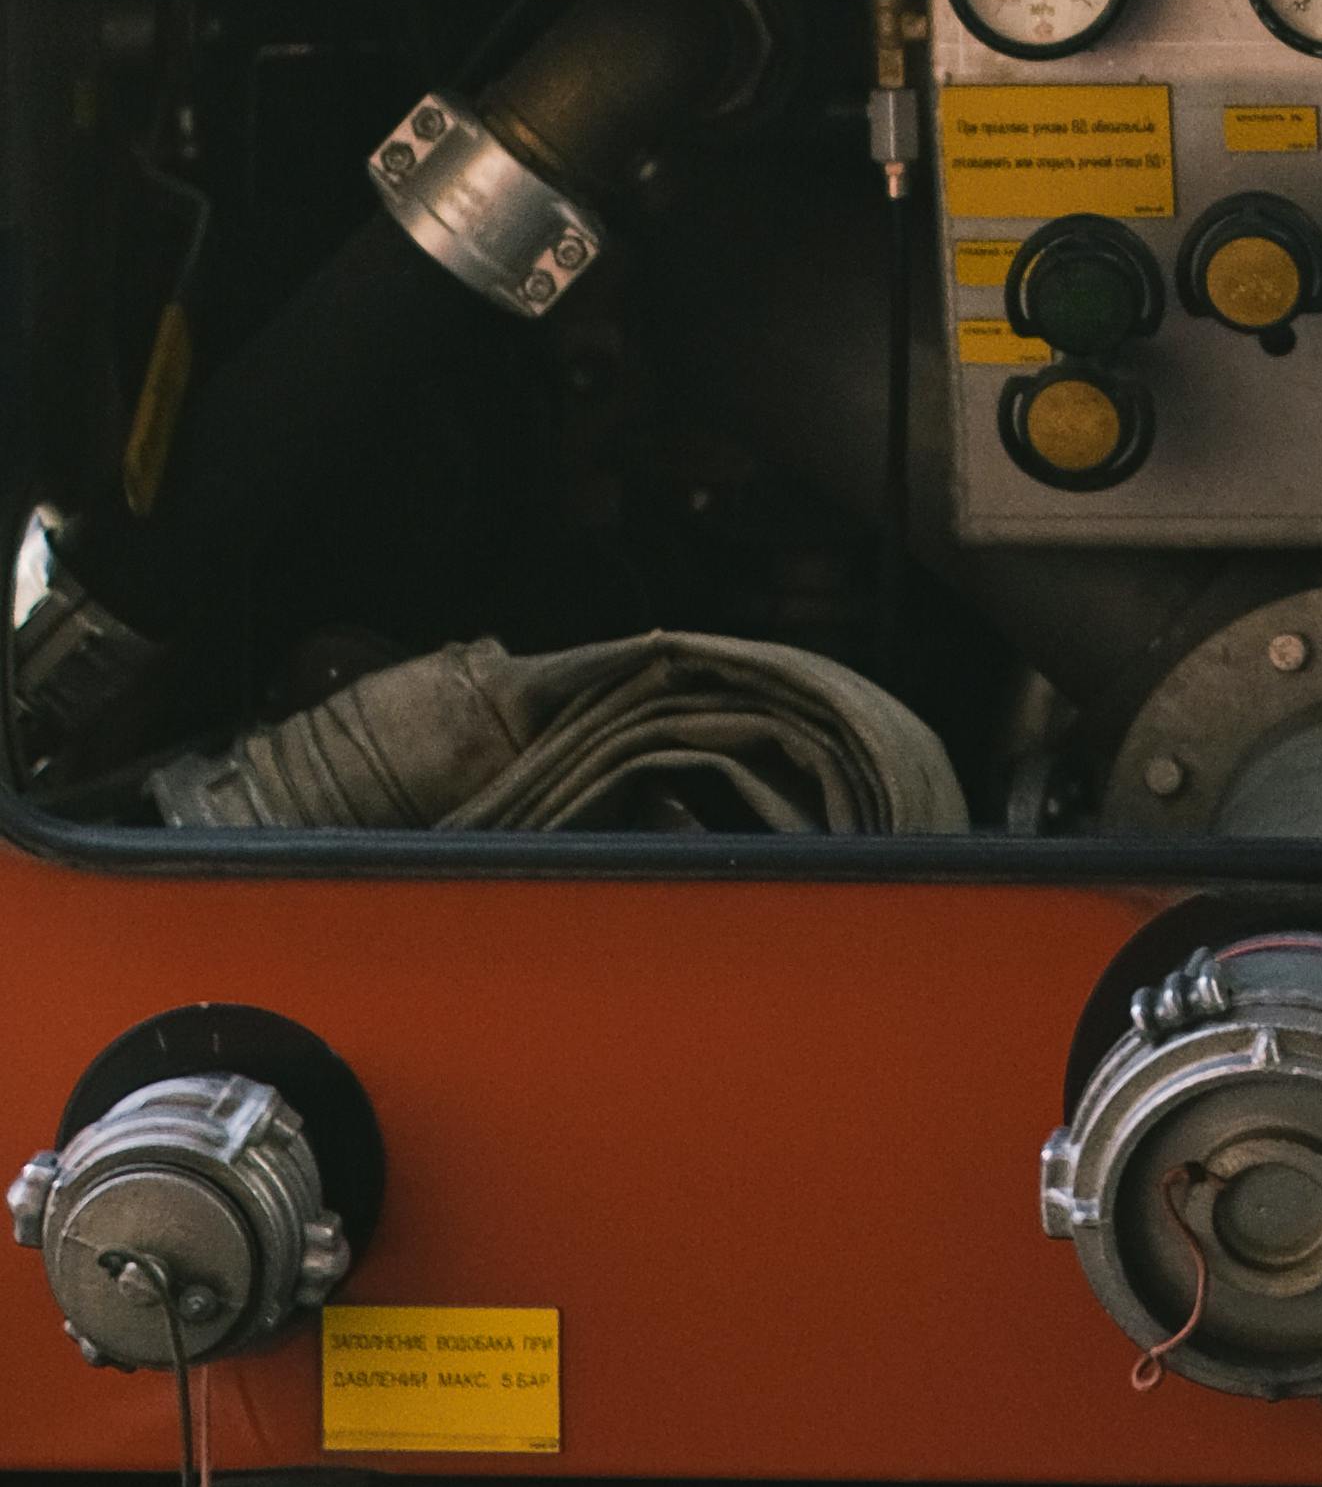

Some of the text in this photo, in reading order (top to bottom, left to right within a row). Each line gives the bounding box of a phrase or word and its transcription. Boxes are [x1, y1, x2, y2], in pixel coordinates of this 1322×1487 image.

[329, 1333, 552, 1354] ЗАПОЛНЕНИЕ ВОДОБАКА ПРИ
[333, 1371, 428, 1388] ДАВЛЕНИИ
